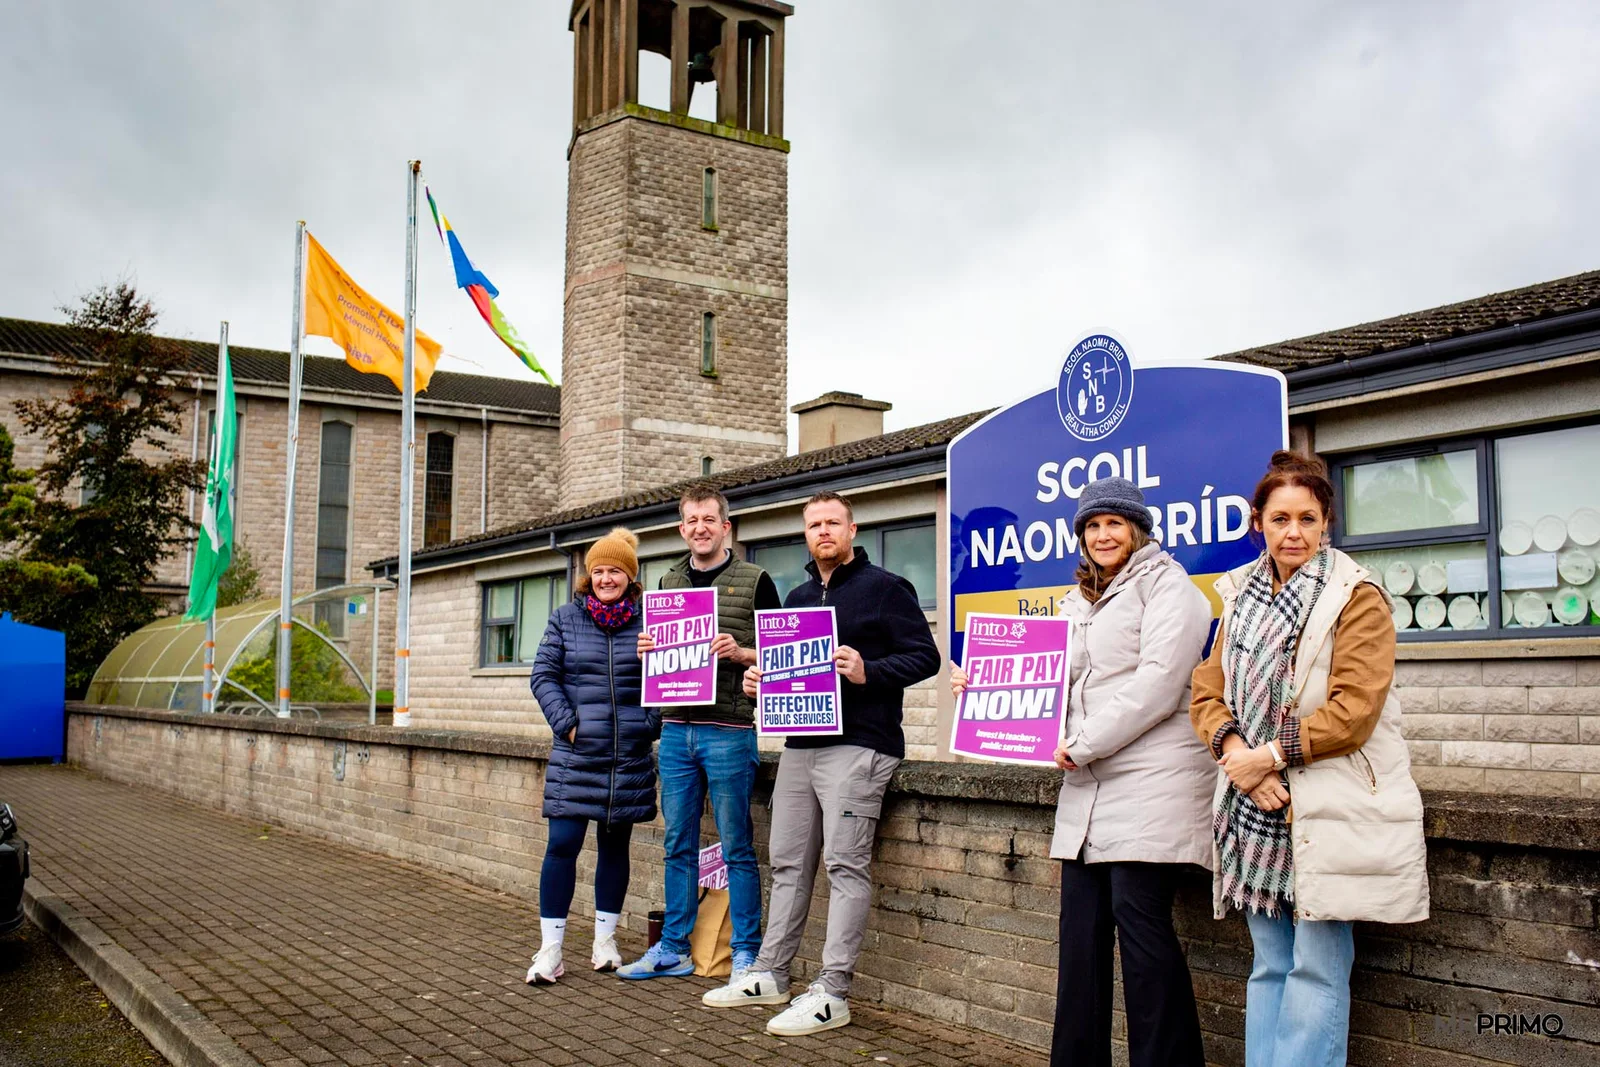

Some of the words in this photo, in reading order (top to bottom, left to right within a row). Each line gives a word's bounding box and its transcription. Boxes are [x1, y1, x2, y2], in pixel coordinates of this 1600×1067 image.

[344, 312, 375, 335] Mental
[1064, 350, 1082, 374] SCOIL
[1082, 338, 1108, 350] NAOMH
[1082, 362, 1091, 380] S
[1088, 378, 1098, 397] N
[1096, 395, 1105, 413] B
[1099, 403, 1126, 434] CONAILL
[1036, 445, 1160, 503] SCOIL
[970, 518, 1084, 568] NAOM
[647, 595, 672, 608] into
[1017, 596, 1054, 616] Béal
[649, 622, 679, 646] FAIR
[683, 616, 712, 640] PAY
[760, 615, 786, 630] into
[971, 619, 1008, 637] into
[647, 642, 710, 677] NOW!
[763, 645, 795, 672] FAIR
[800, 637, 831, 665] PAY
[968, 657, 1015, 686] FAIR
[1020, 653, 1062, 682] PAY
[764, 695, 833, 713] EFFECTIVE
[962, 687, 1056, 721] NOW!
[764, 713, 791, 725] PUBLIC
[794, 712, 834, 725] SERVICES!
[976, 729, 998, 739] Invest
[1005, 732, 1036, 743] teachers
[980, 740, 1003, 750] public
